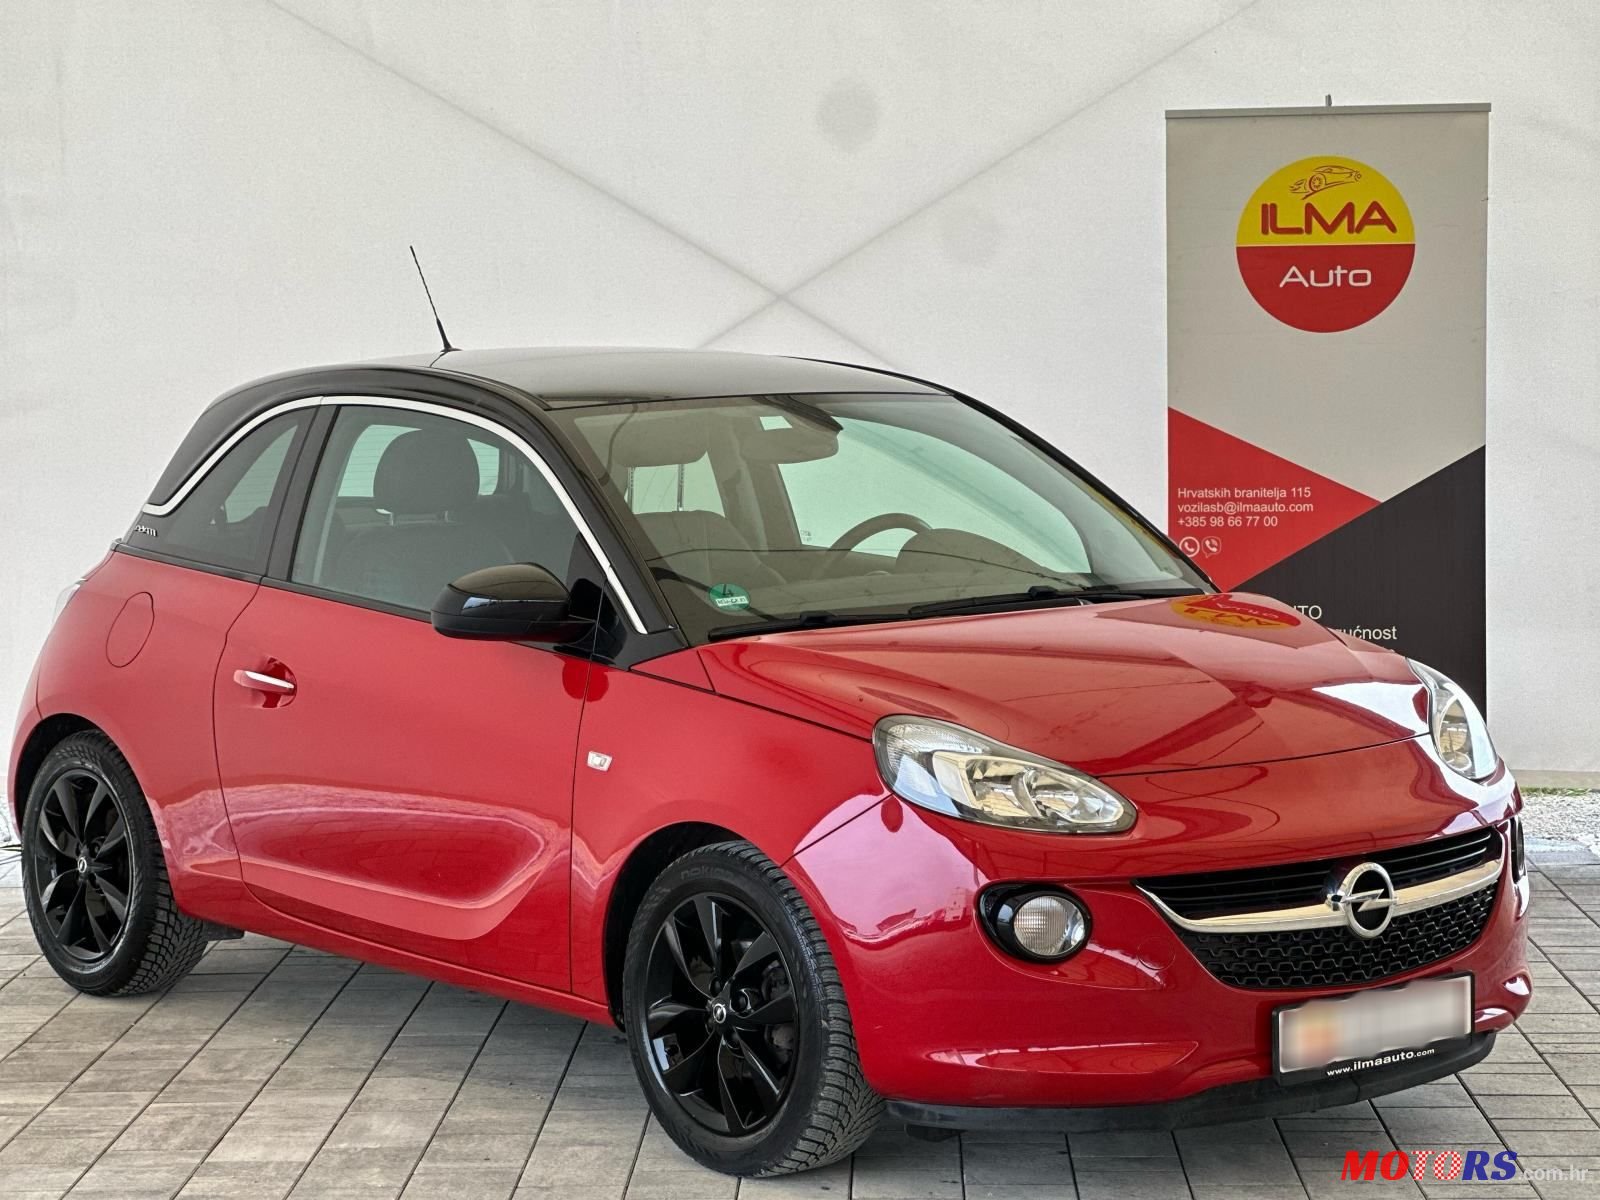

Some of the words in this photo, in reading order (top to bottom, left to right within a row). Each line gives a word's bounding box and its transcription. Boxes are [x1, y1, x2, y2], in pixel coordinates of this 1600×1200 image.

[1261, 200, 1397, 236] ILMA
[1279, 265, 1372, 288] Auto
[1178, 487, 1231, 498] Hrvatskih
[1234, 487, 1287, 500] branitelja
[1291, 487, 1311, 498] 115
[1177, 502, 1314, 515] vozilasb@ilmaauto.com
[1177, 516, 1207, 527] +385
[1210, 516, 1224, 527] 98
[1227, 516, 1242, 527] 66
[1246, 516, 1260, 527] 77
[1263, 516, 1278, 527] 00
[1293, 605, 1322, 620] TO
[1326, 1047, 1435, 1077] www.ilmaauto.com
